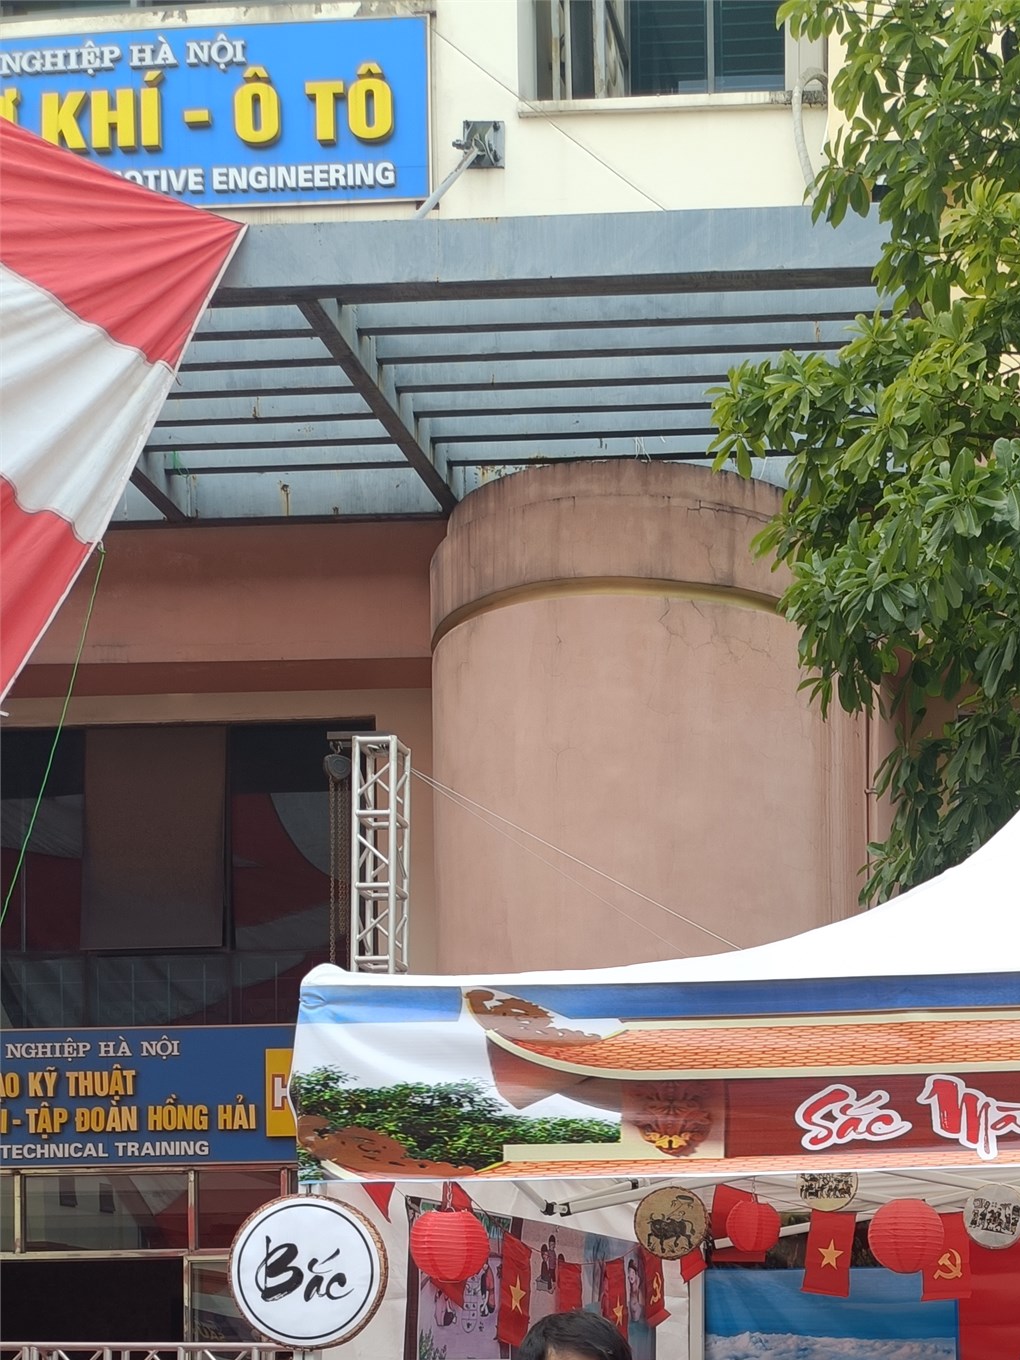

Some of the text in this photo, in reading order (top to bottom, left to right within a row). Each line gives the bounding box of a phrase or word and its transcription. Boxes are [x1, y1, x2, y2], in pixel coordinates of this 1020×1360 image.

[0, 33, 248, 76] NGHIỆP HÀ NỘI
[41, 70, 163, 154] KHÍ
[234, 66, 280, 146] Ô
[305, 62, 394, 145] TÔ
[212, 162, 396, 193] ENGINEERING
[5, 1035, 181, 1062] NGHIỆP HÀ NỘI
[28, 1066, 58, 1097] KỸ
[65, 1064, 136, 1101] THUẬT
[25, 1101, 69, 1140] TẬP
[74, 1100, 138, 1133] ĐOÀN
[147, 1094, 209, 1131] HỒNG
[217, 1094, 257, 1130] HẢI
[0, 1140, 209, 1159] TECHNICAL TRAINING
[254, 1235, 355, 1303] Bắc
